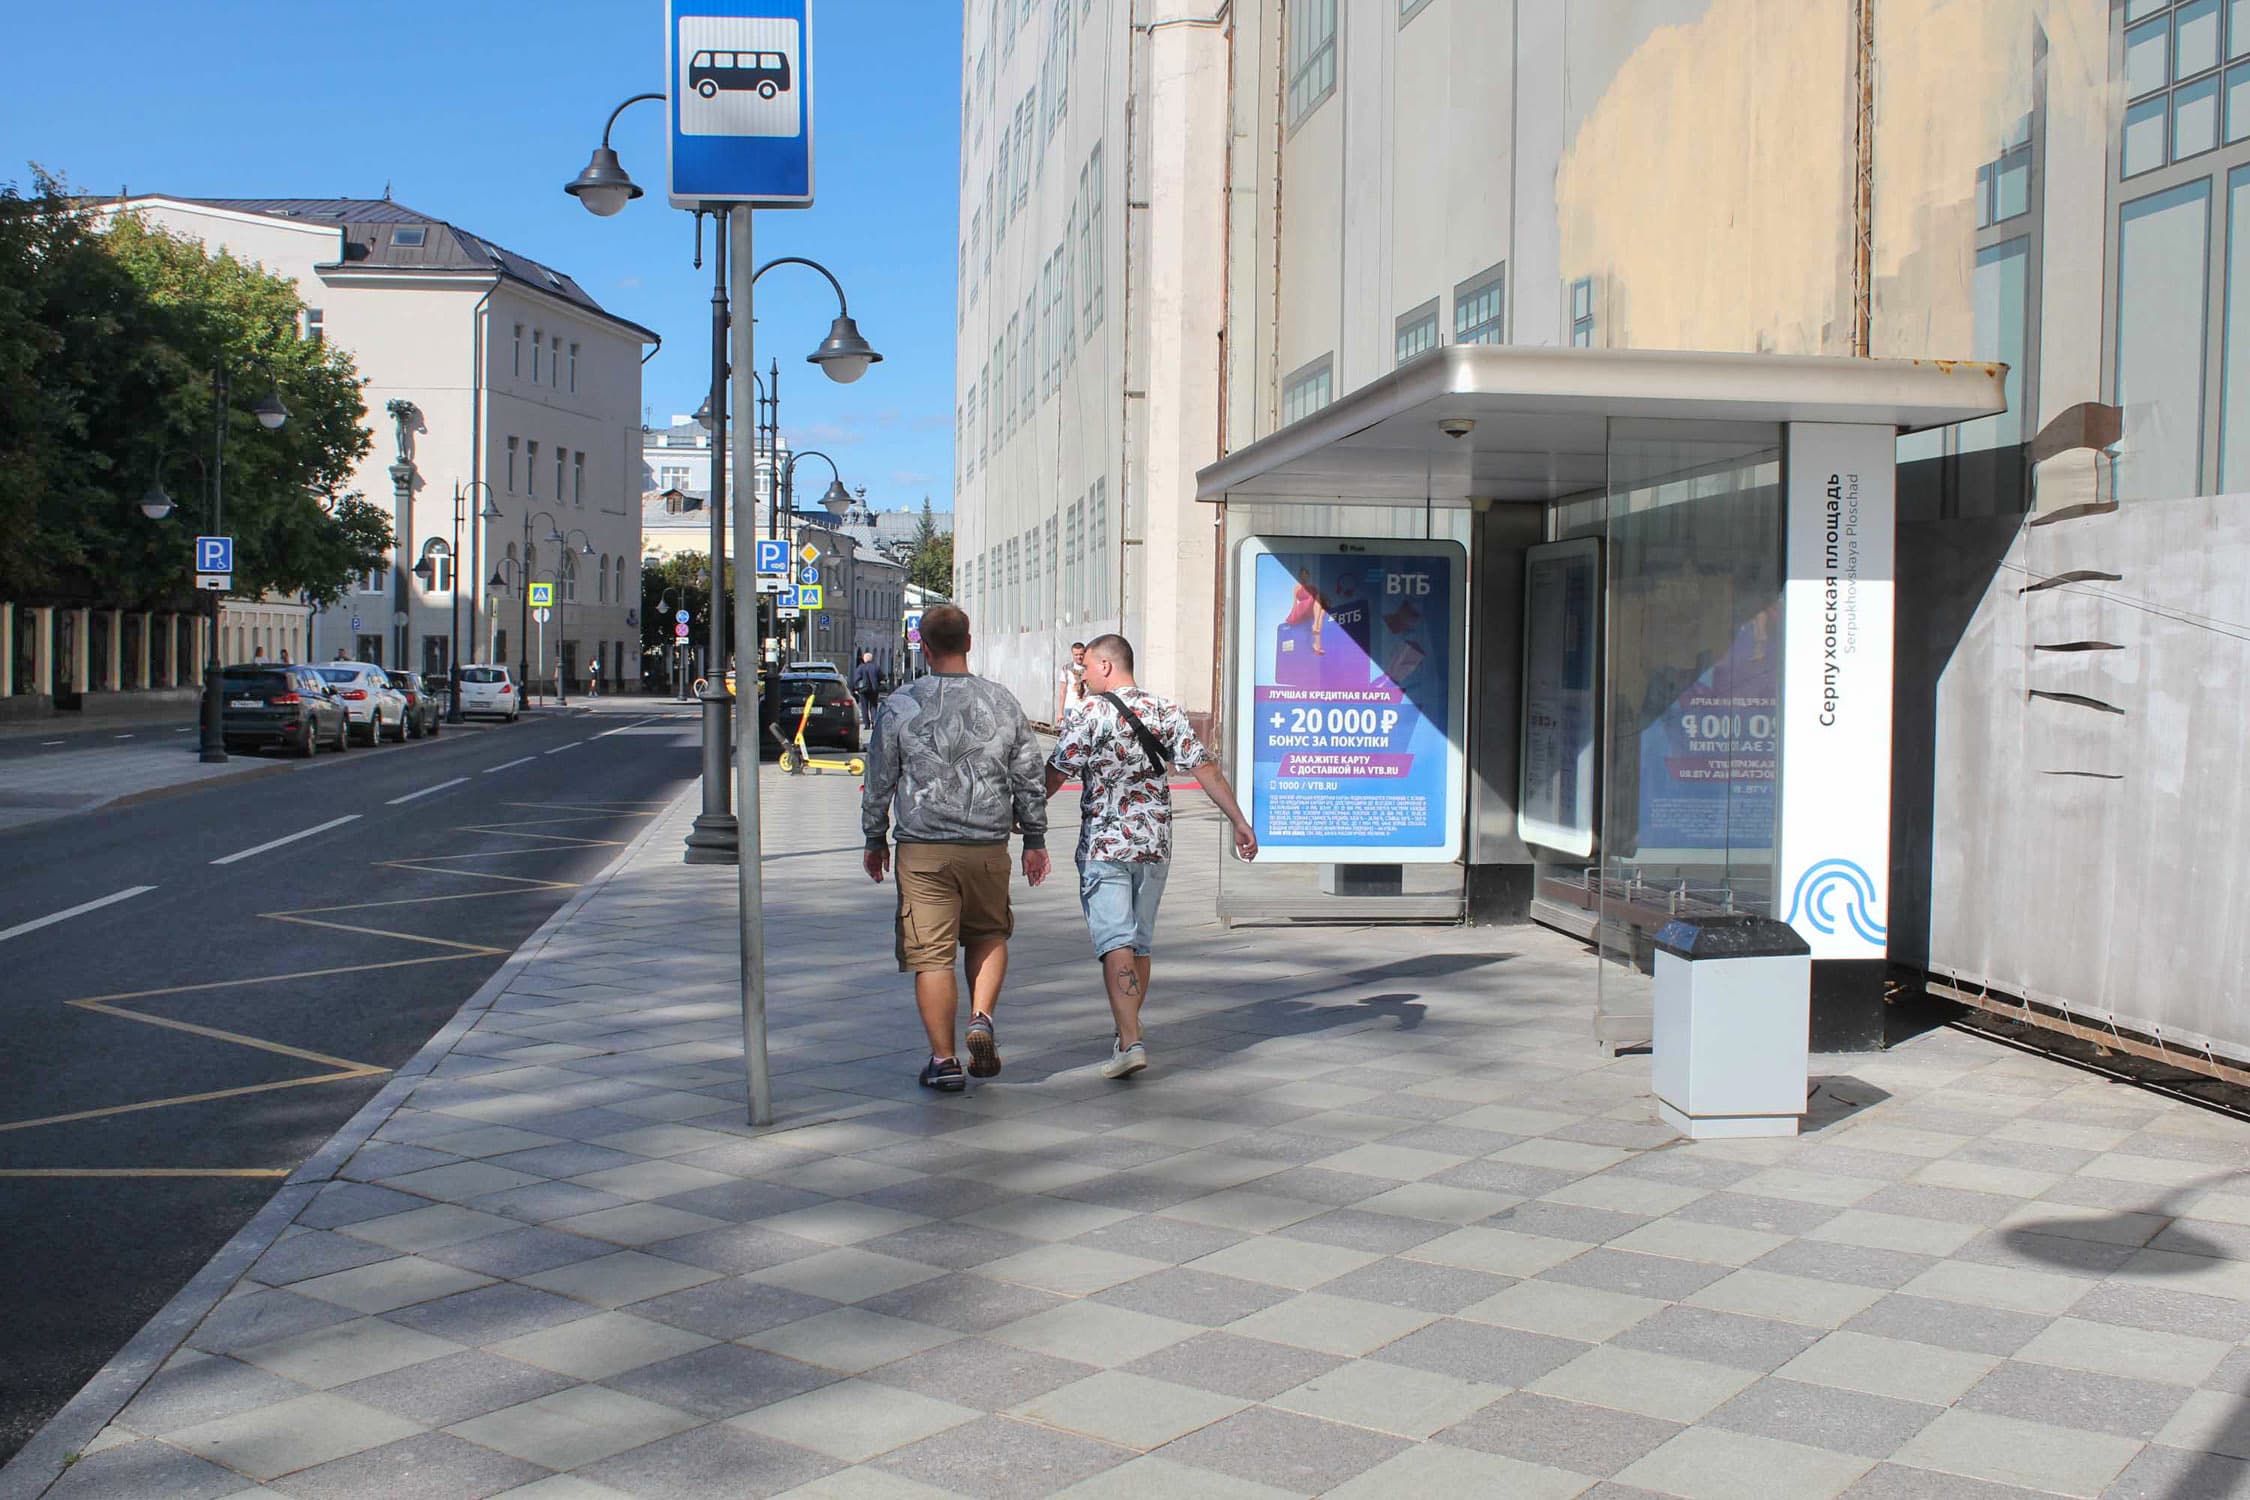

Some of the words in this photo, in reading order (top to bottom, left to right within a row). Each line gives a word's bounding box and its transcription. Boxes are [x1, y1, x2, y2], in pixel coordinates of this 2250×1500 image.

[1846, 473, 1859, 536] Ploschad
[1825, 473, 1843, 569] площадь
[205, 541, 224, 568] P
[761, 543, 780, 570] P
[1386, 574, 1431, 595] ВТБ
[1844, 541, 1860, 654] Serpukhovskaya
[1338, 609, 1362, 625] ВТБ
[1819, 575, 1840, 727] Серпуховская
[1268, 690, 1307, 699] ЛУЧШАЯ
[1309, 691, 1360, 700] КРЕДИТНАЯ
[1362, 692, 1391, 700] КАРТА
[1290, 707, 1323, 733] 20
[1327, 708, 1377, 734] 000
[1269, 735, 1311, 747] БОНУС
[1312, 736, 1328, 747] ЗА
[1331, 736, 1389, 748] ПОКУПКИ
[1289, 754, 1339, 764] ЗАКАЖИТЕ
[1341, 755, 1370, 765] КАРТУ
[1289, 765, 1297, 775] С
[1297, 763, 1351, 776] ДОСТАВКОЙ
[1353, 766, 1366, 775] НА
[1368, 766, 1399, 775] VTB.RU
[1278, 781, 1299, 791] 1000
[1308, 781, 1338, 791] VTB.RU
